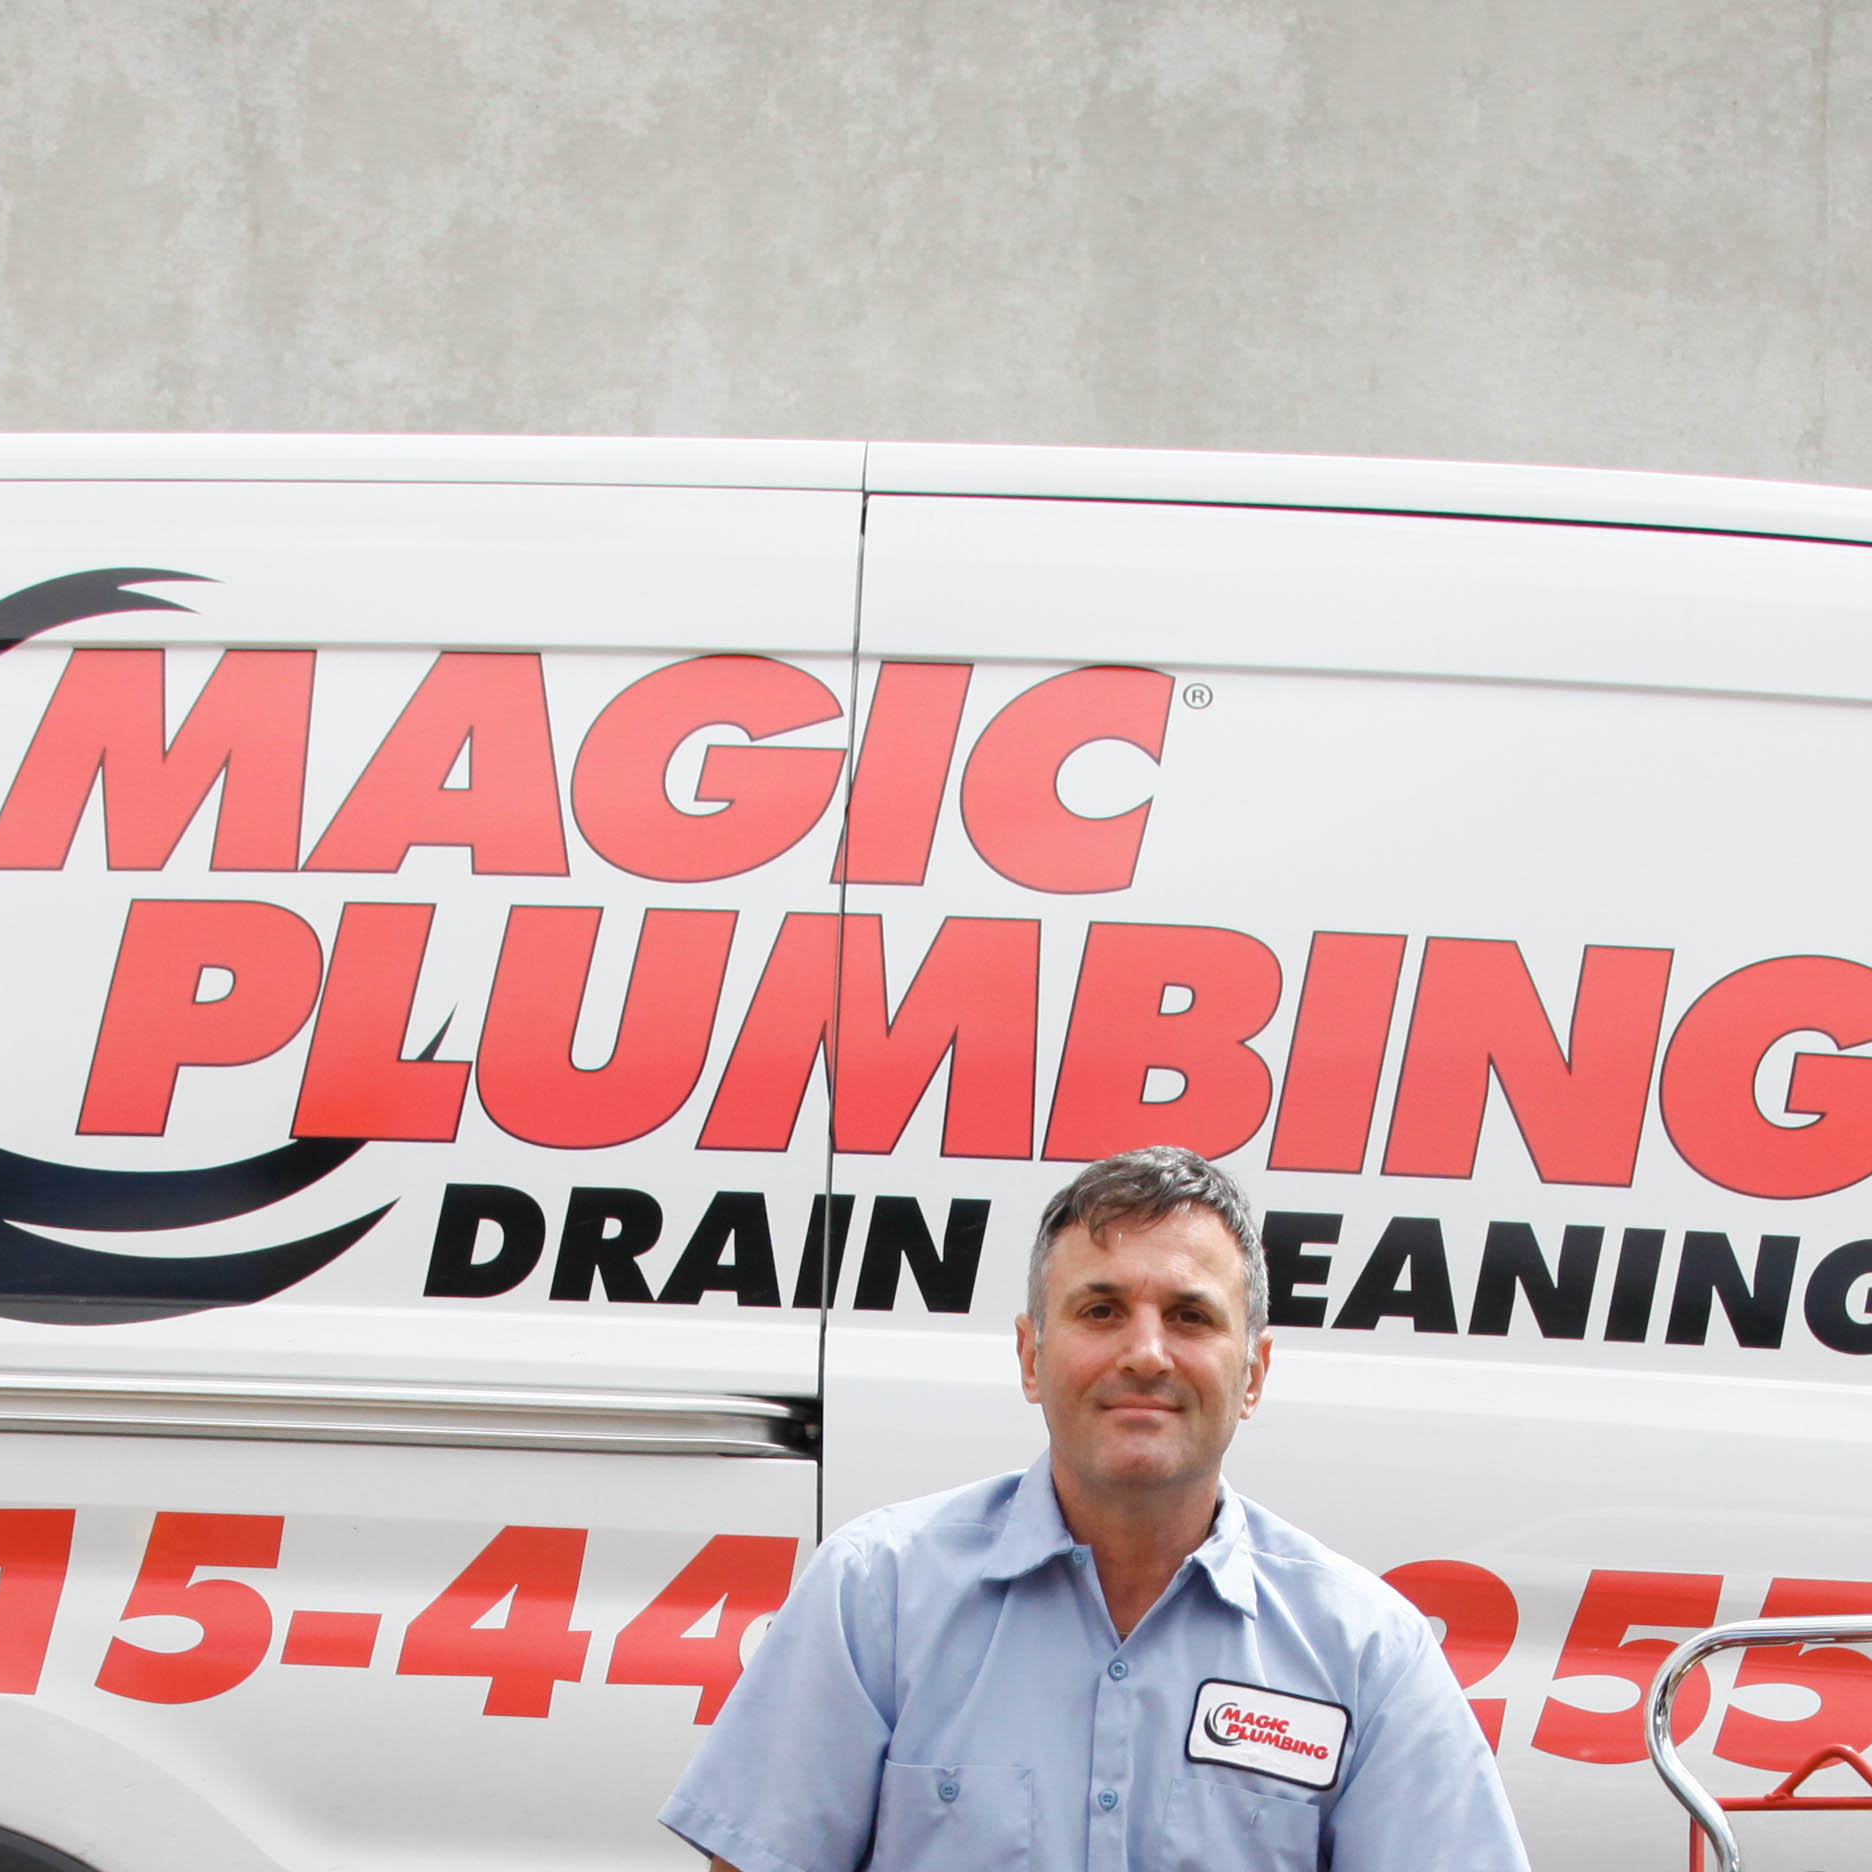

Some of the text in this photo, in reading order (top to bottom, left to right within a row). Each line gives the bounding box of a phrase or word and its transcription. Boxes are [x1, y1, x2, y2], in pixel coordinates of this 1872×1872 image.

[423, 1182, 992, 1314] DRAIN
[1220, 1707, 1290, 1734] MAGIC
[1225, 1723, 1329, 1760] PLUMBING
